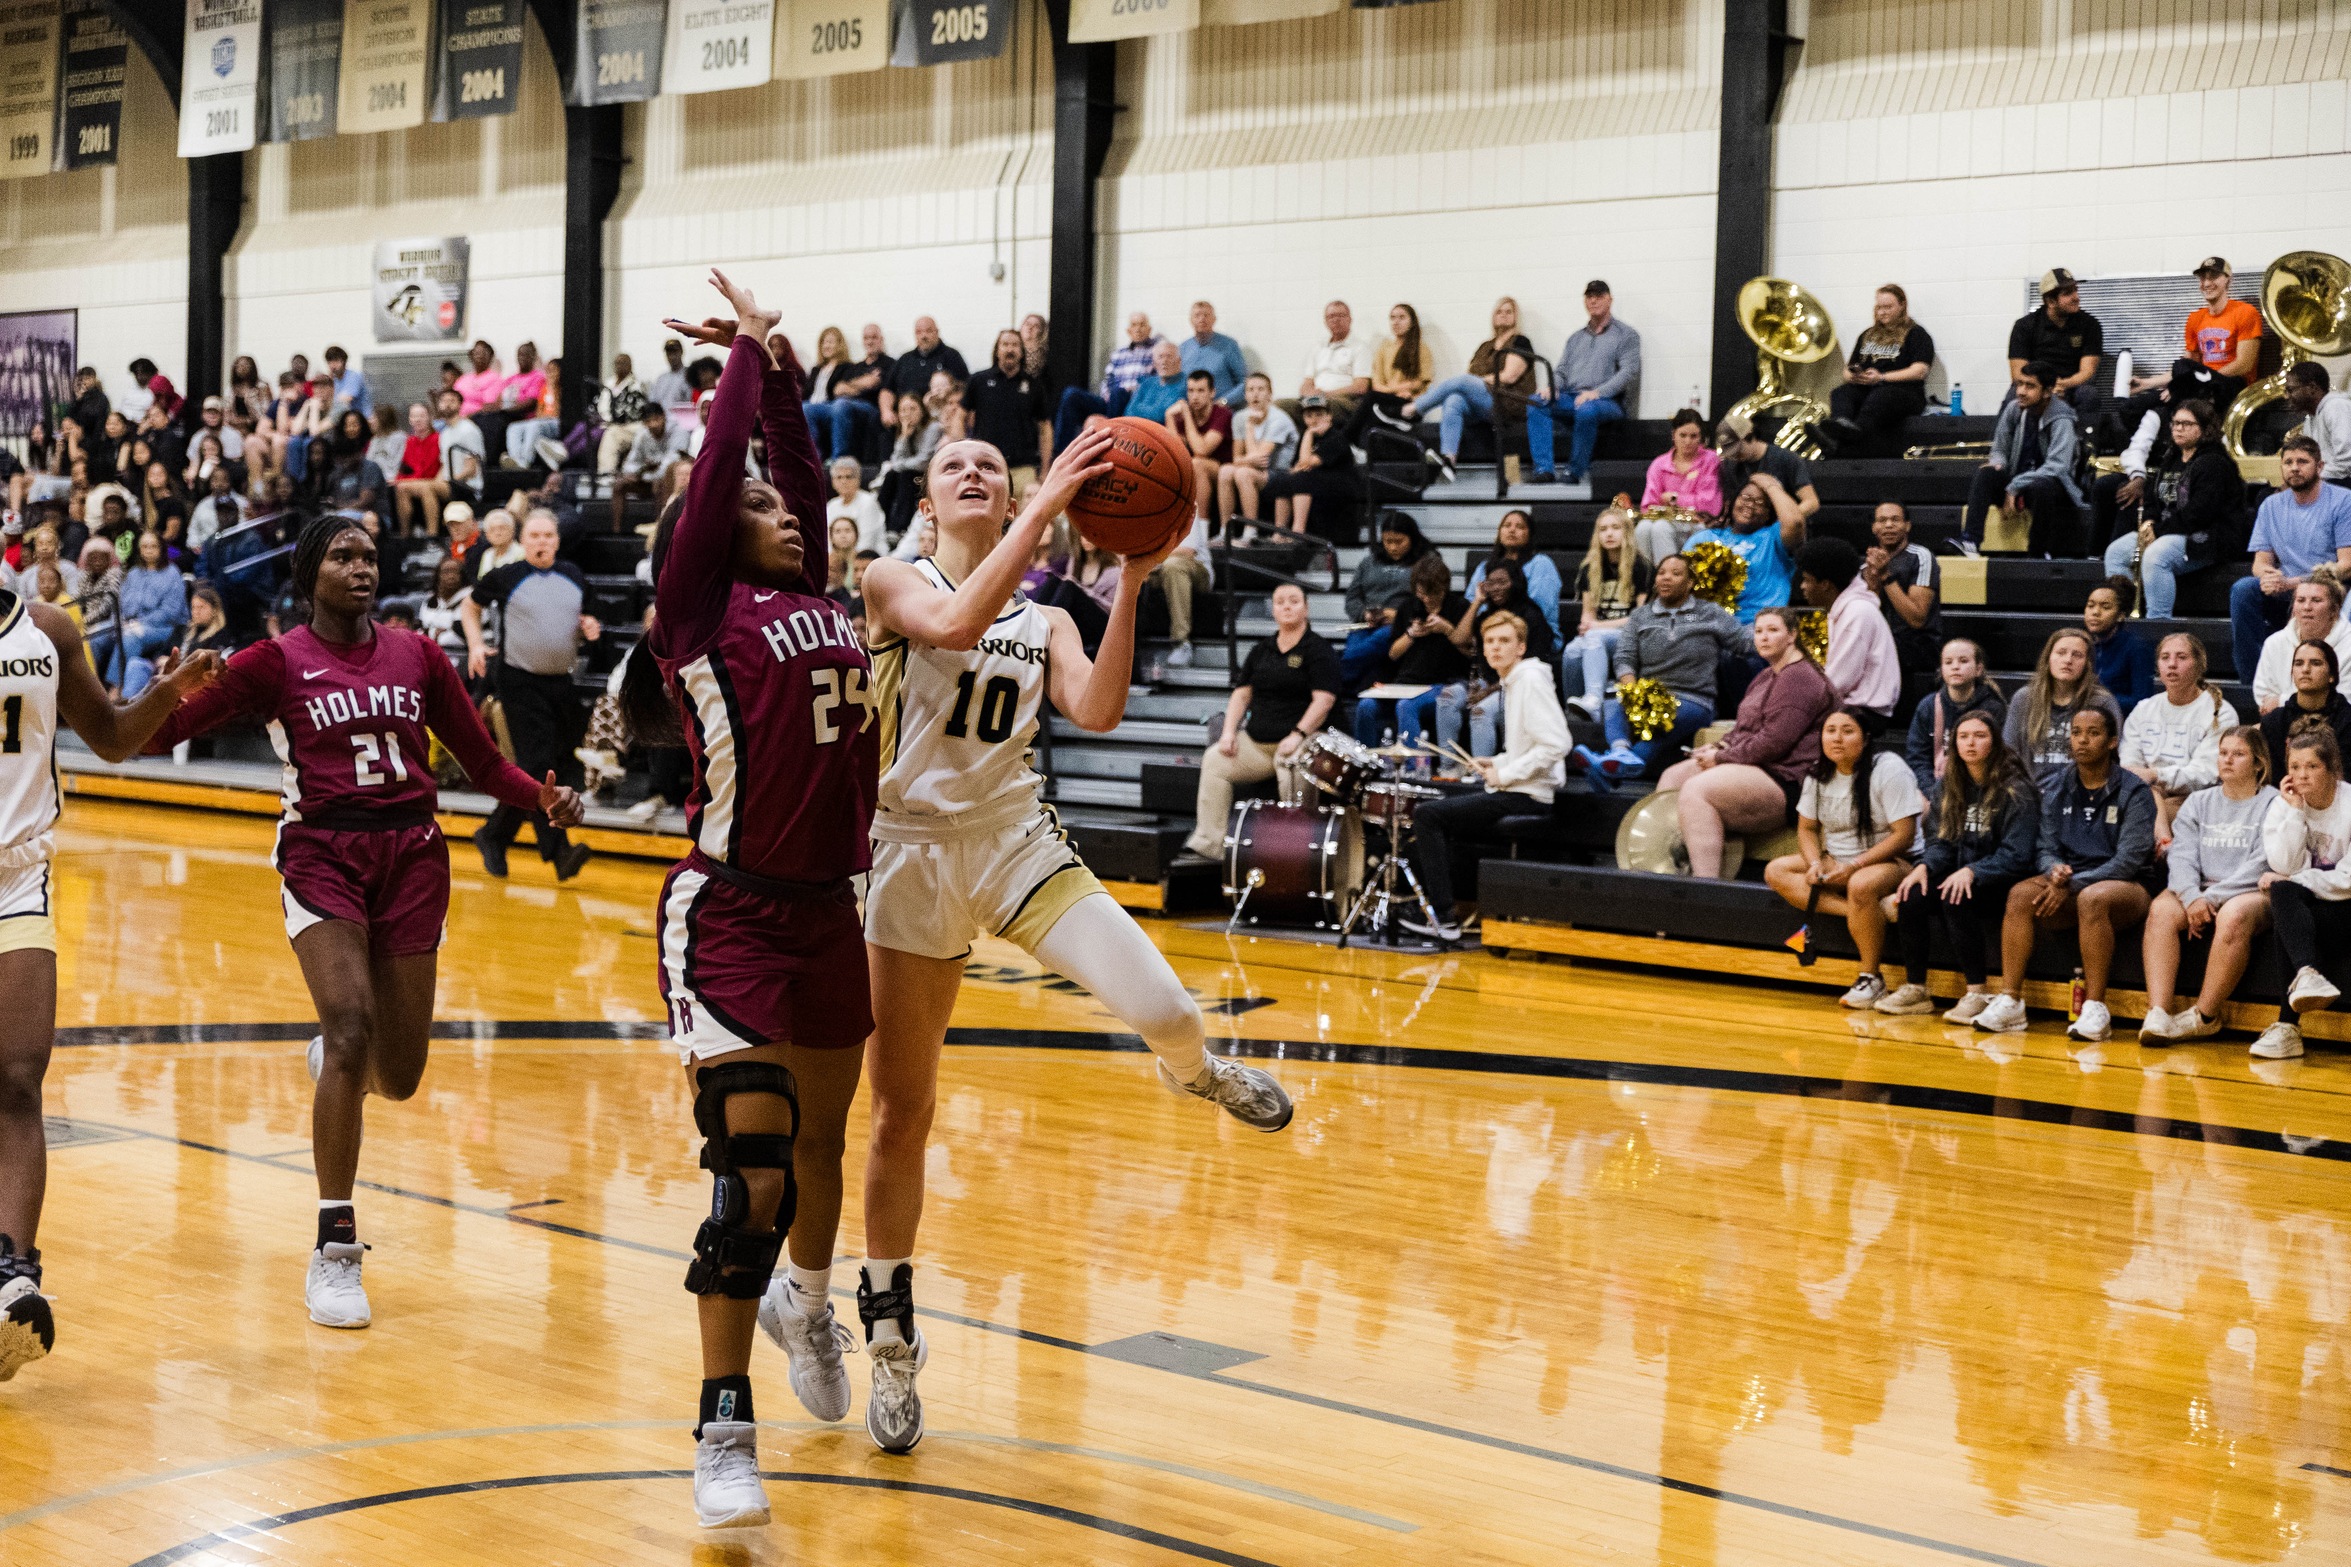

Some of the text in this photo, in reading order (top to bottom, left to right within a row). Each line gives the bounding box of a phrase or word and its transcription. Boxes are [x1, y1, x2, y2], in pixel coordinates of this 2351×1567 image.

[448, 25, 522, 52] CHAMPIONS
[811, 18, 862, 54] 2005
[931, 4, 989, 46] 2005
[598, 51, 646, 86] 2004
[703, 36, 749, 71] 2004
[367, 80, 407, 113] 2004
[462, 66, 505, 103] 2004
[79, 123, 111, 154] 2001
[206, 108, 239, 137] 2001
[10, 133, 39, 160] 1999
[1112, 436, 1158, 467] DING
[761, 608, 866, 664] HOLME
[972, 637, 1048, 665] RRIOR
[0, 655, 53, 678] IORS
[305, 685, 421, 731] HOLMES
[811, 668, 879, 745] 24
[945, 670, 1020, 744] 10
[350, 731, 408, 787] 21
[676, 996, 694, 1035] H
